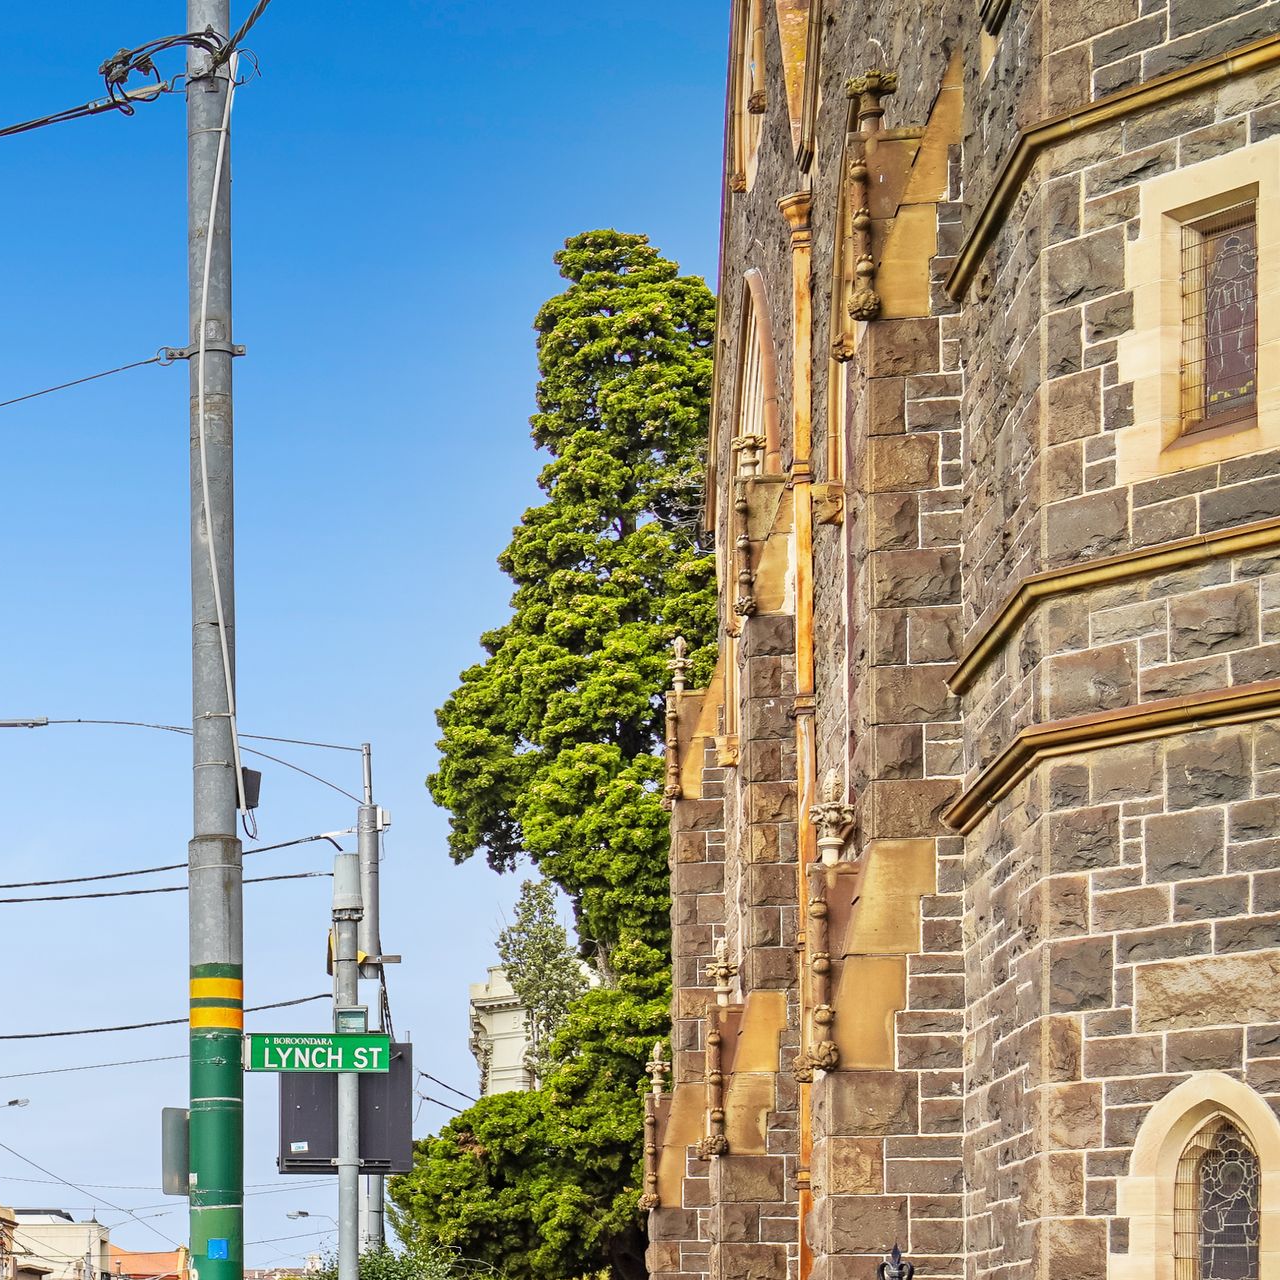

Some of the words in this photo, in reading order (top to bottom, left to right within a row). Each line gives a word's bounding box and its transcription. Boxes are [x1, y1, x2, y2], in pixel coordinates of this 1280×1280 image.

[273, 1037, 333, 1045] BOROONDARA
[264, 1047, 341, 1068] LYNCH
[353, 1047, 382, 1068] ST
